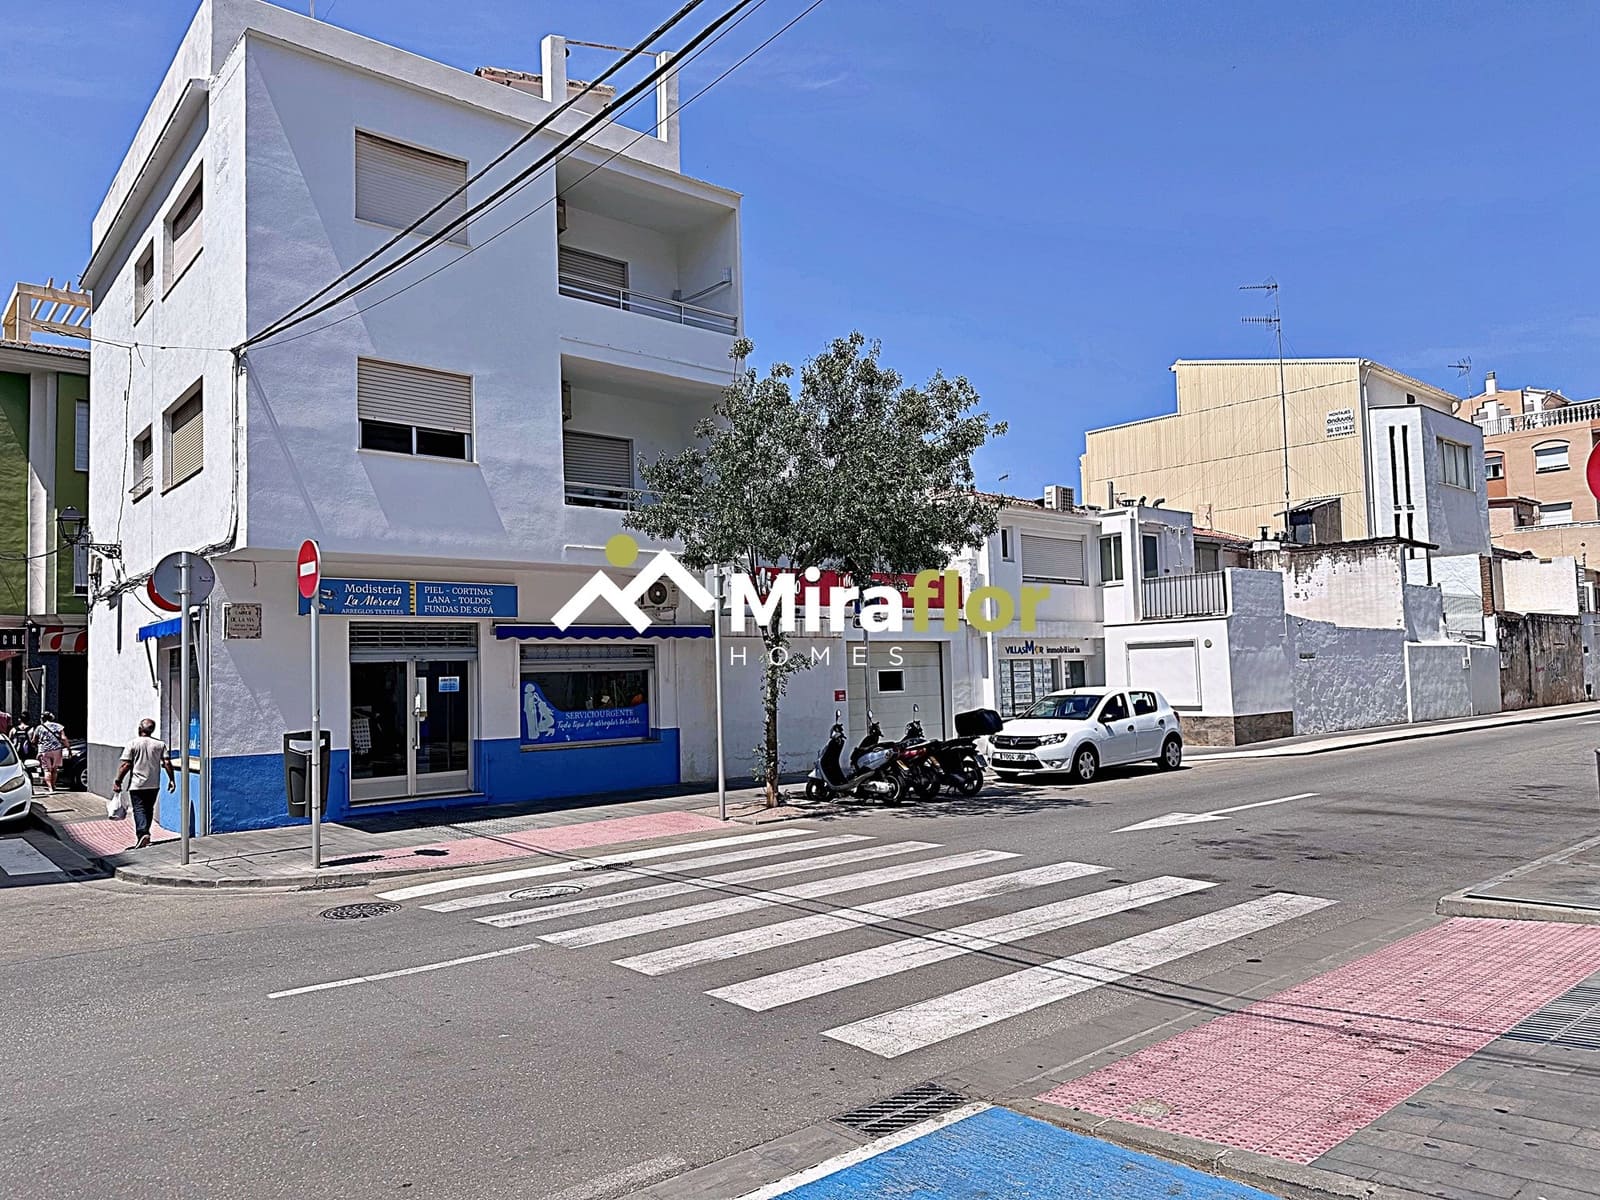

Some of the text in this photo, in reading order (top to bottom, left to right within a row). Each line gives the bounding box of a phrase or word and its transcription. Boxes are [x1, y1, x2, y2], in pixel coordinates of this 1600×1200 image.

[344, 583, 403, 595] Modistería
[424, 586, 444, 594] PIEL
[451, 587, 494, 596] CORTINAS
[344, 595, 401, 607] La Merced
[427, 596, 451, 604] LANA
[458, 597, 491, 605] TOLDOS
[424, 605, 459, 614] FUNDAS
[460, 606, 472, 614] DE
[1046, 645, 1080, 654] inmobiliaria
